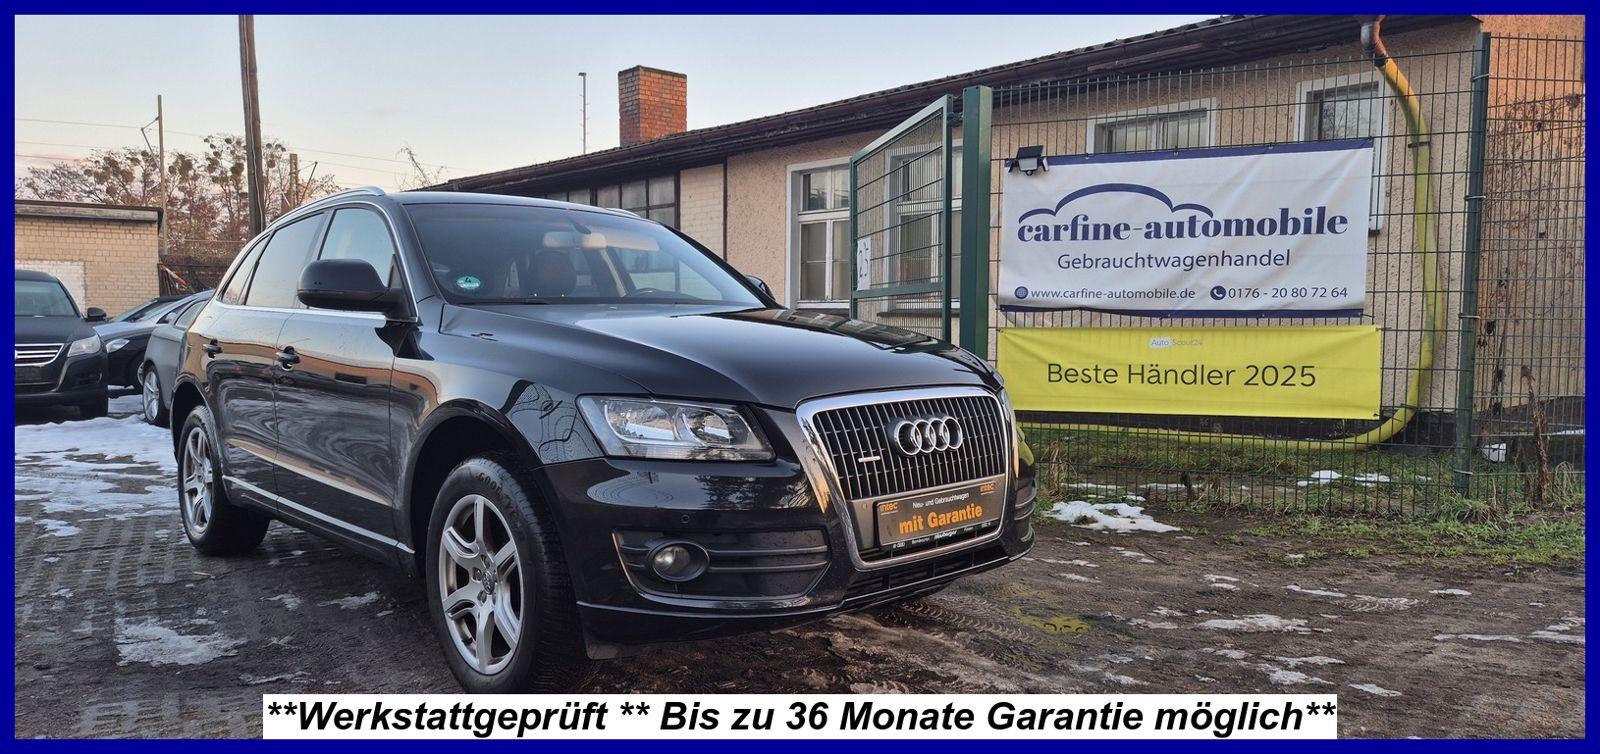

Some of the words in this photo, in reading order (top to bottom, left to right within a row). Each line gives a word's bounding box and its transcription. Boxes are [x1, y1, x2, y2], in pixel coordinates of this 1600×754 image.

[1017, 205, 1349, 242] carfine-automobile
[1057, 249, 1291, 272] Gebrauchtwagenhandel
[1031, 287, 1196, 300] www.carfine-automobile.de
[1228, 287, 1260, 299] 0176
[1271, 287, 1288, 299] 20
[1291, 287, 1308, 299] 80
[1311, 287, 1328, 299] 72
[1330, 287, 1349, 299] 64
[1047, 363, 1119, 385] Beste
[1128, 363, 1236, 387] Händler
[1243, 364, 1317, 388] 2025
[935, 492, 970, 505] Gebrauchtwagen
[899, 513, 925, 535] mit
[927, 502, 983, 529] Garantie
